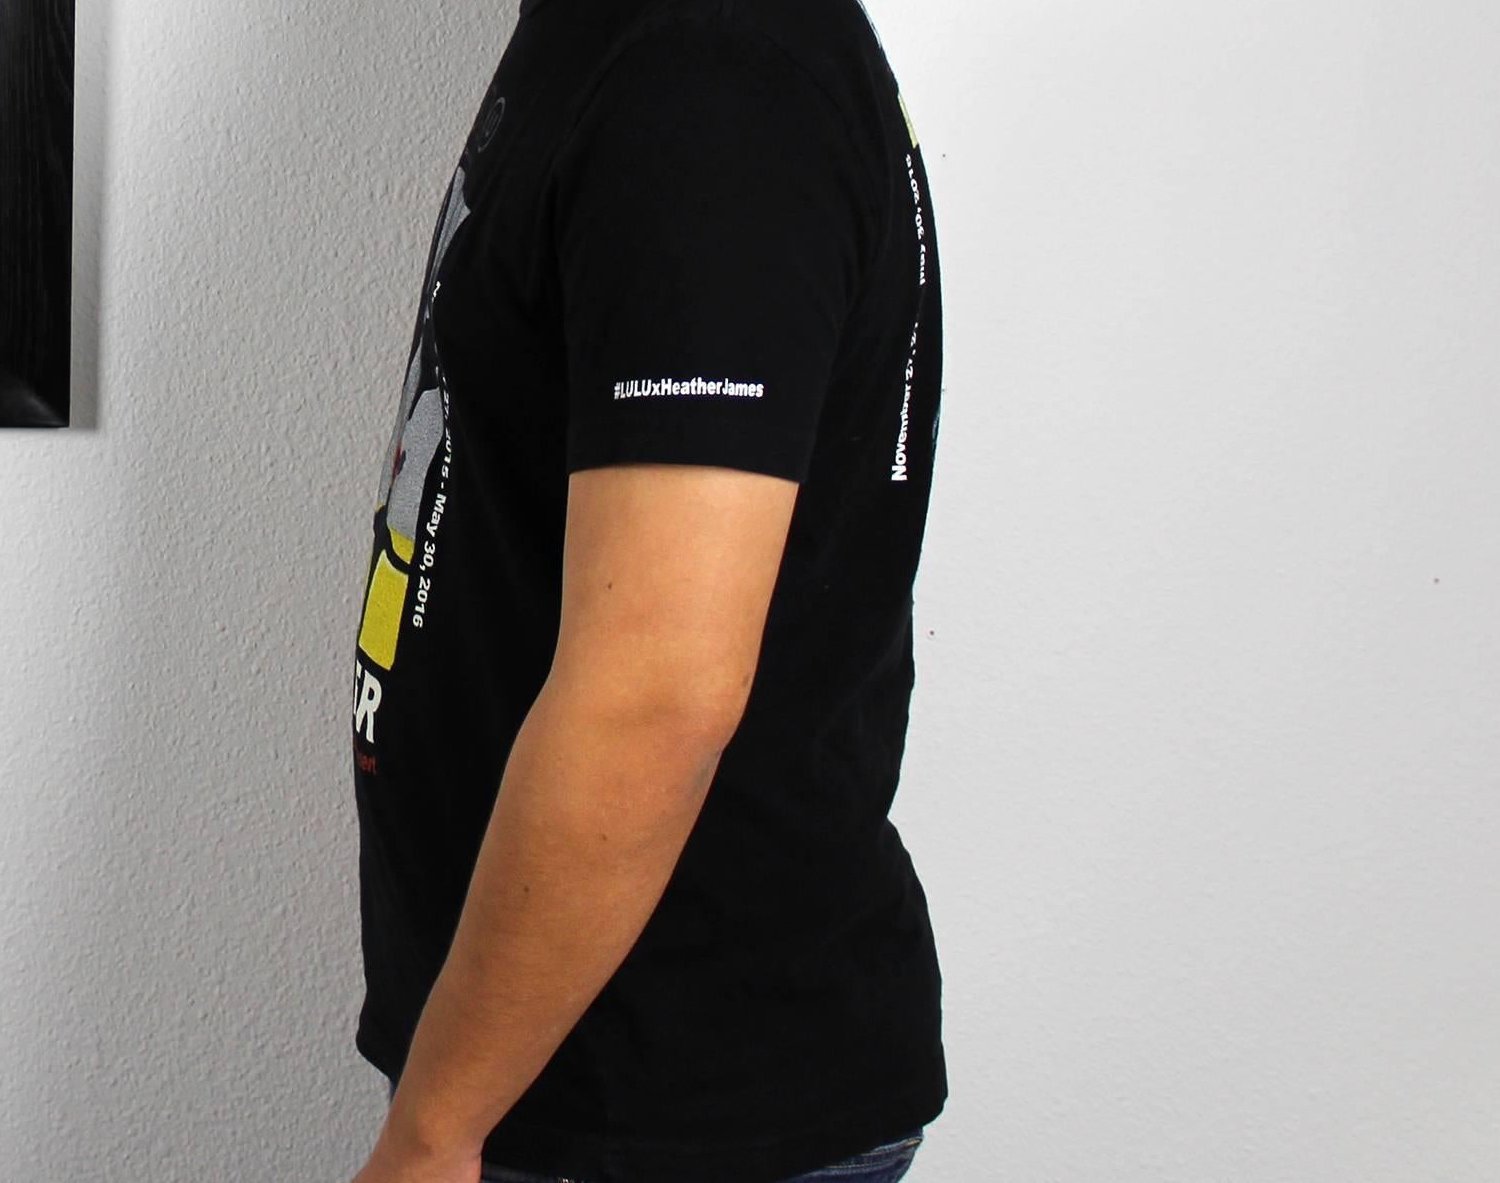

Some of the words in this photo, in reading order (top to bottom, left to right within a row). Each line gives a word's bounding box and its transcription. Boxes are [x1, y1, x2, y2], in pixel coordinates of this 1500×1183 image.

[905, 153, 920, 205] 2016
[914, 206, 925, 241] 30,
[613, 376, 765, 400] #LULUxHeatherJames
[890, 383, 912, 482] November
[426, 492, 447, 538] May
[419, 540, 436, 572] 30,
[412, 575, 431, 628] 2016
